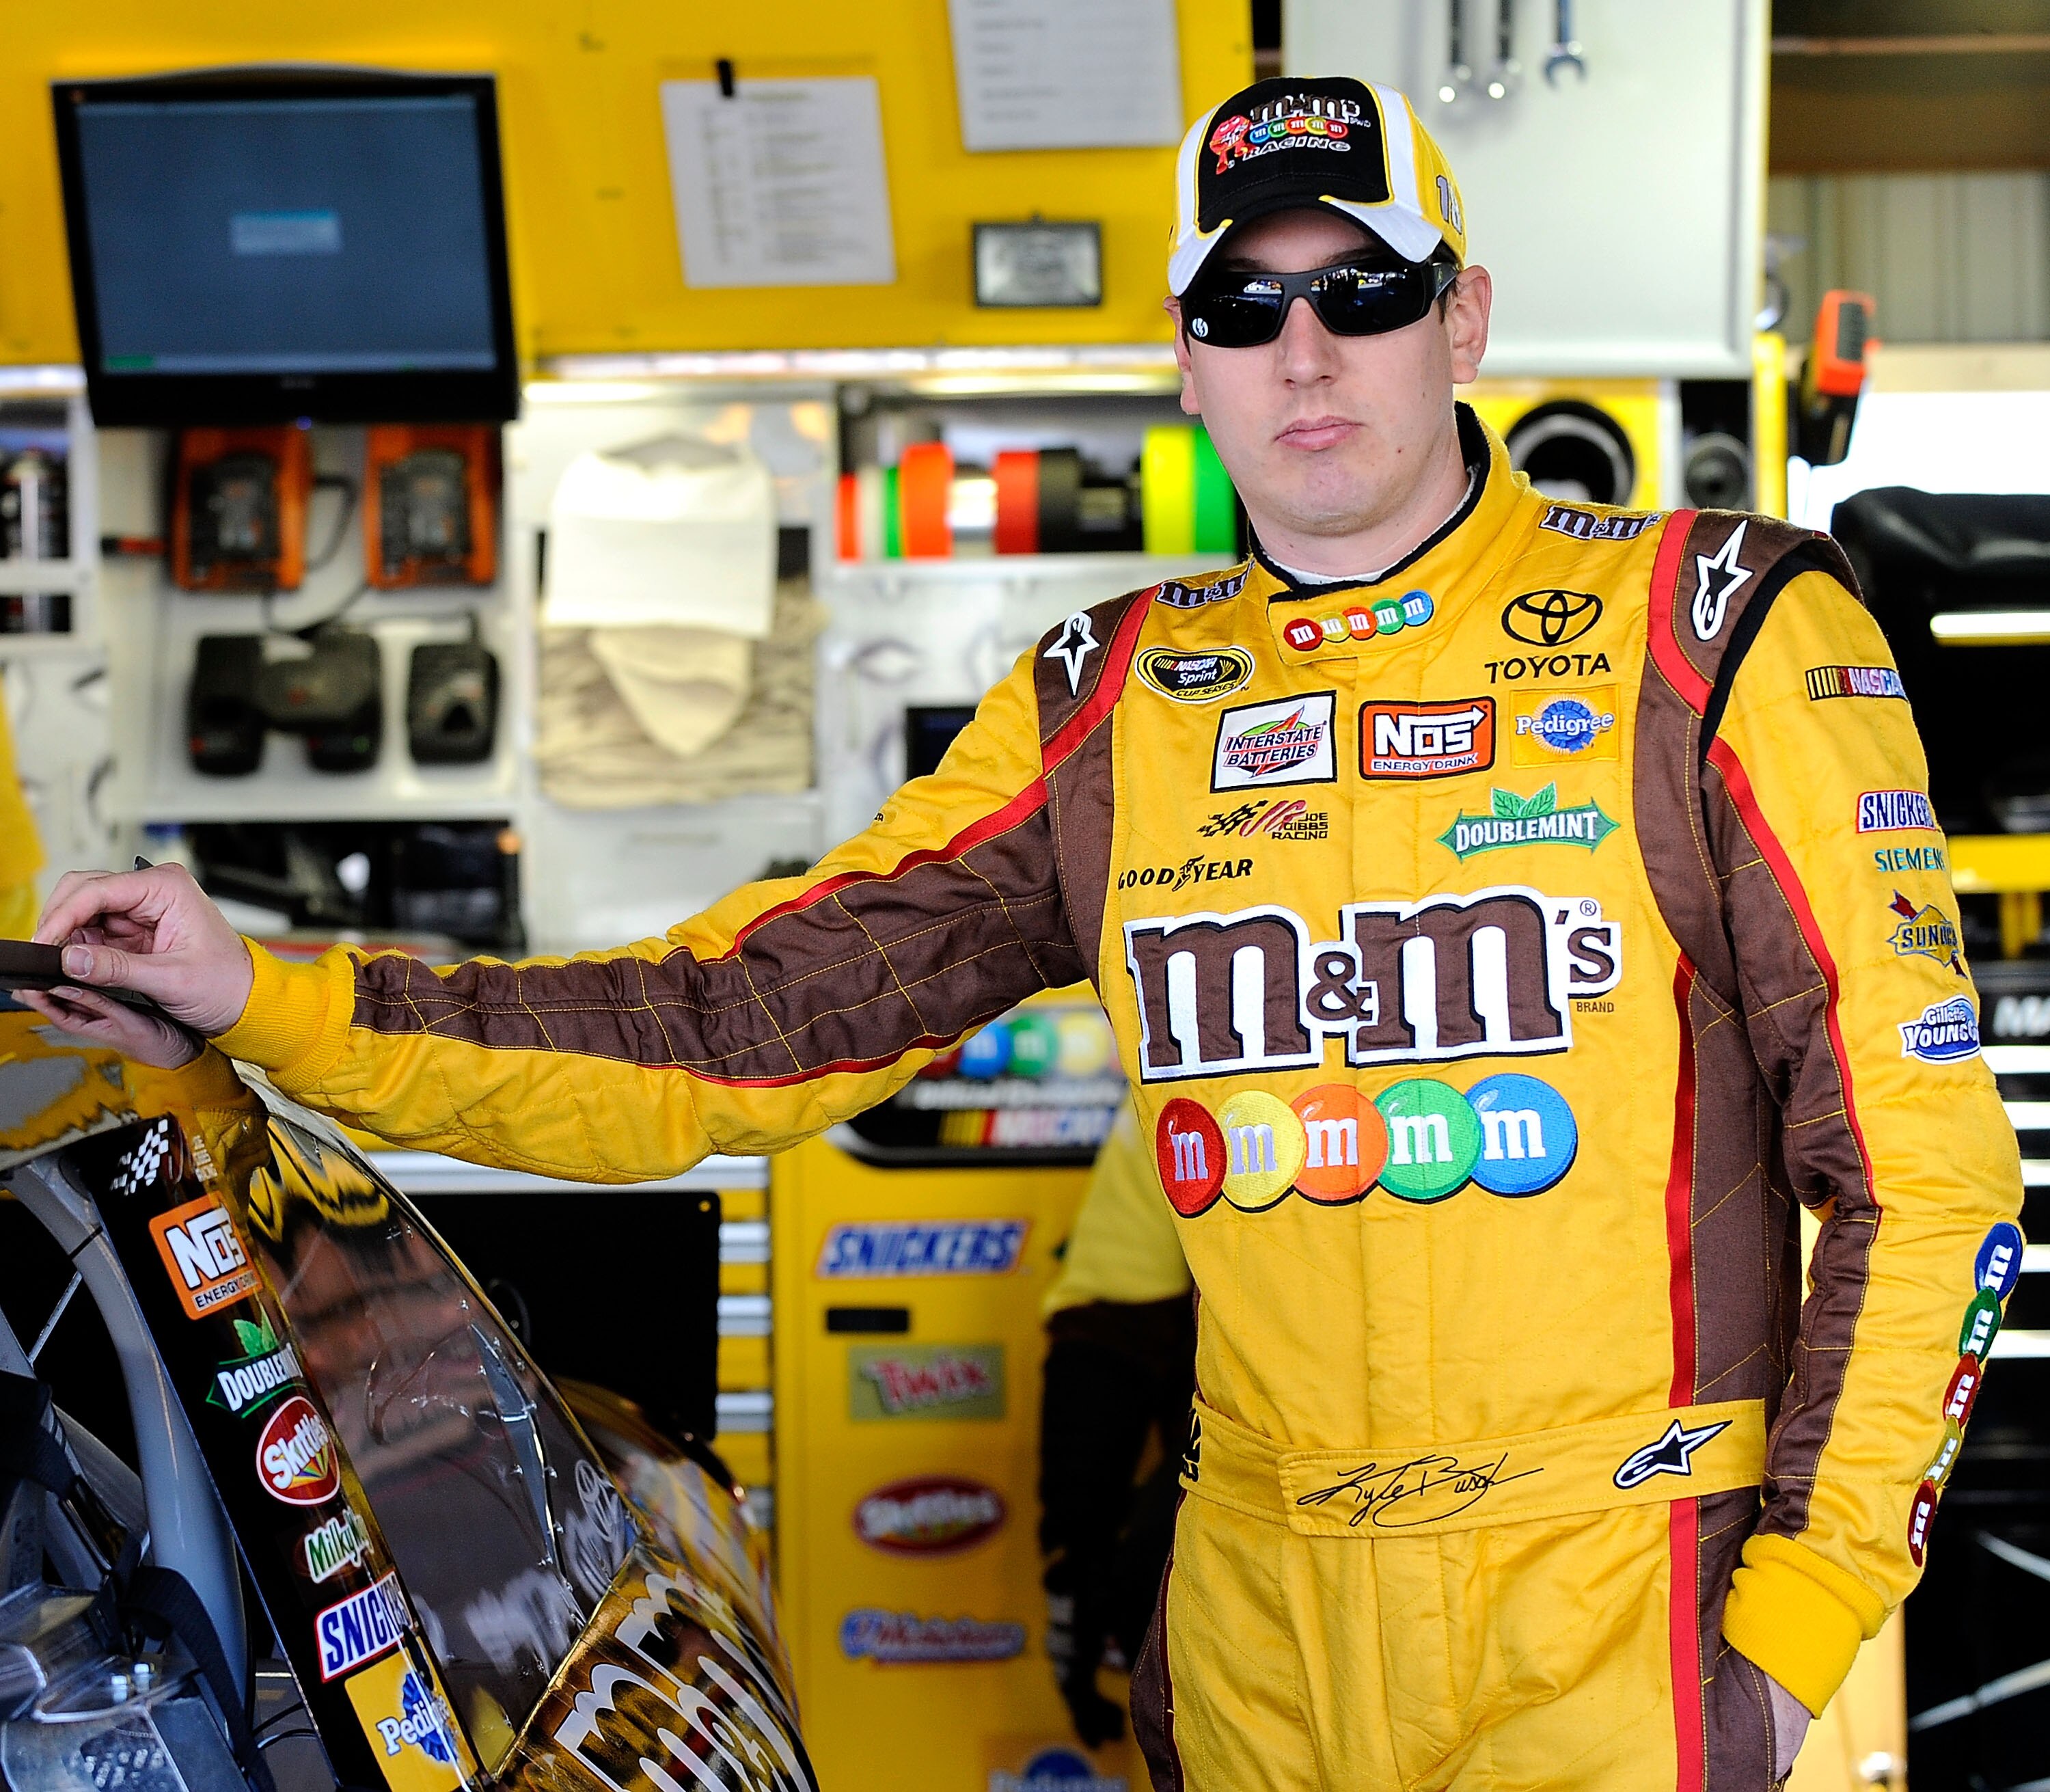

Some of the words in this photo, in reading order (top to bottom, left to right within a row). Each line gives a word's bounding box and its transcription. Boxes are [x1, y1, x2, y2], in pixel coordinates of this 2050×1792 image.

[1242, 136, 1352, 161] RACING
[1177, 668, 1218, 685] Sprint
[1484, 653, 1611, 683] TOYOTA
[1373, 705, 1488, 757] NOS
[1516, 713, 1615, 735] Pedigree
[1225, 725, 1324, 751] INTERSTATE
[1229, 743, 1317, 766] BATTERIES
[1373, 759, 1432, 770] ENERGY
[1434, 754, 1477, 770] DRINK
[1299, 813, 1328, 821] JOE
[1272, 831, 1328, 840] RACING
[1456, 811, 1600, 852] DOUBLEMINT
[1576, 1001, 1614, 1014] BRAND
[824, 1225, 1018, 1273] SNICKERS
